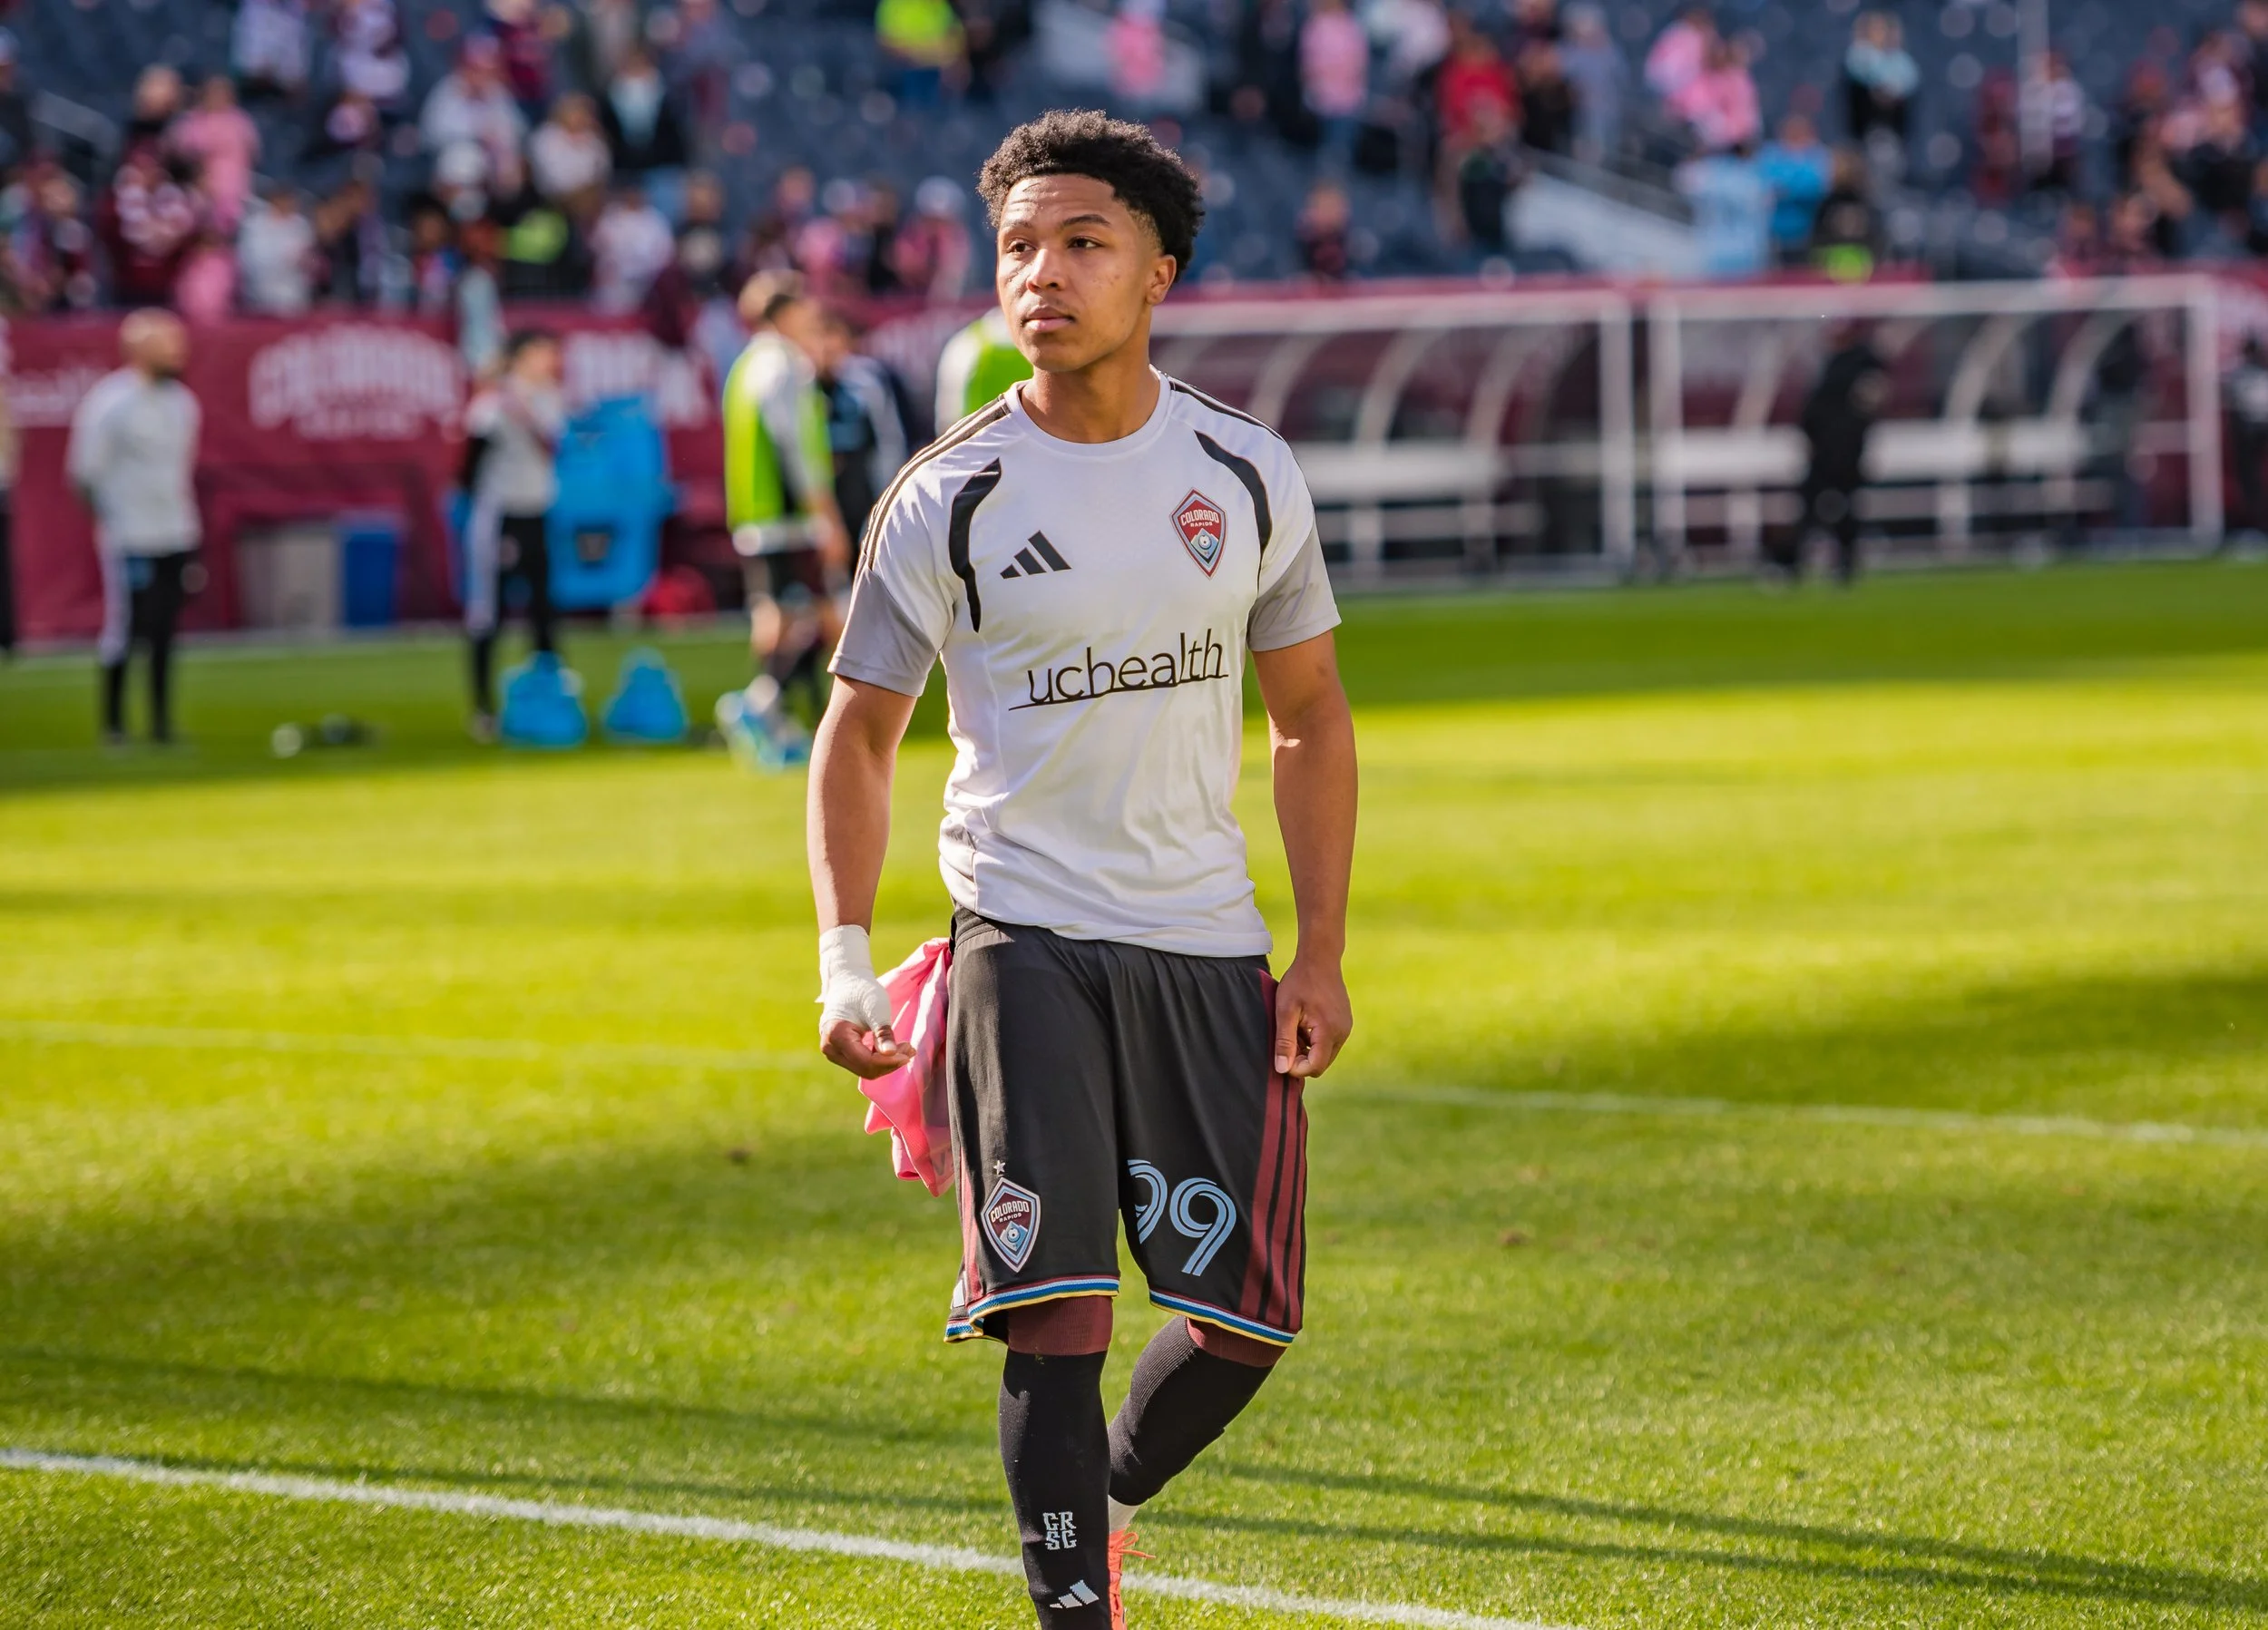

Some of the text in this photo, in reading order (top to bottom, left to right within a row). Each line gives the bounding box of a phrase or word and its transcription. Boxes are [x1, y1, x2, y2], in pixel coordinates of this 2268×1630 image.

[1180, 509, 1220, 526] COLORADO
[1009, 628, 1228, 711] uchealth
[990, 1200, 1030, 1223] COLORADO
[999, 1213, 1022, 1223] RAPIDS
